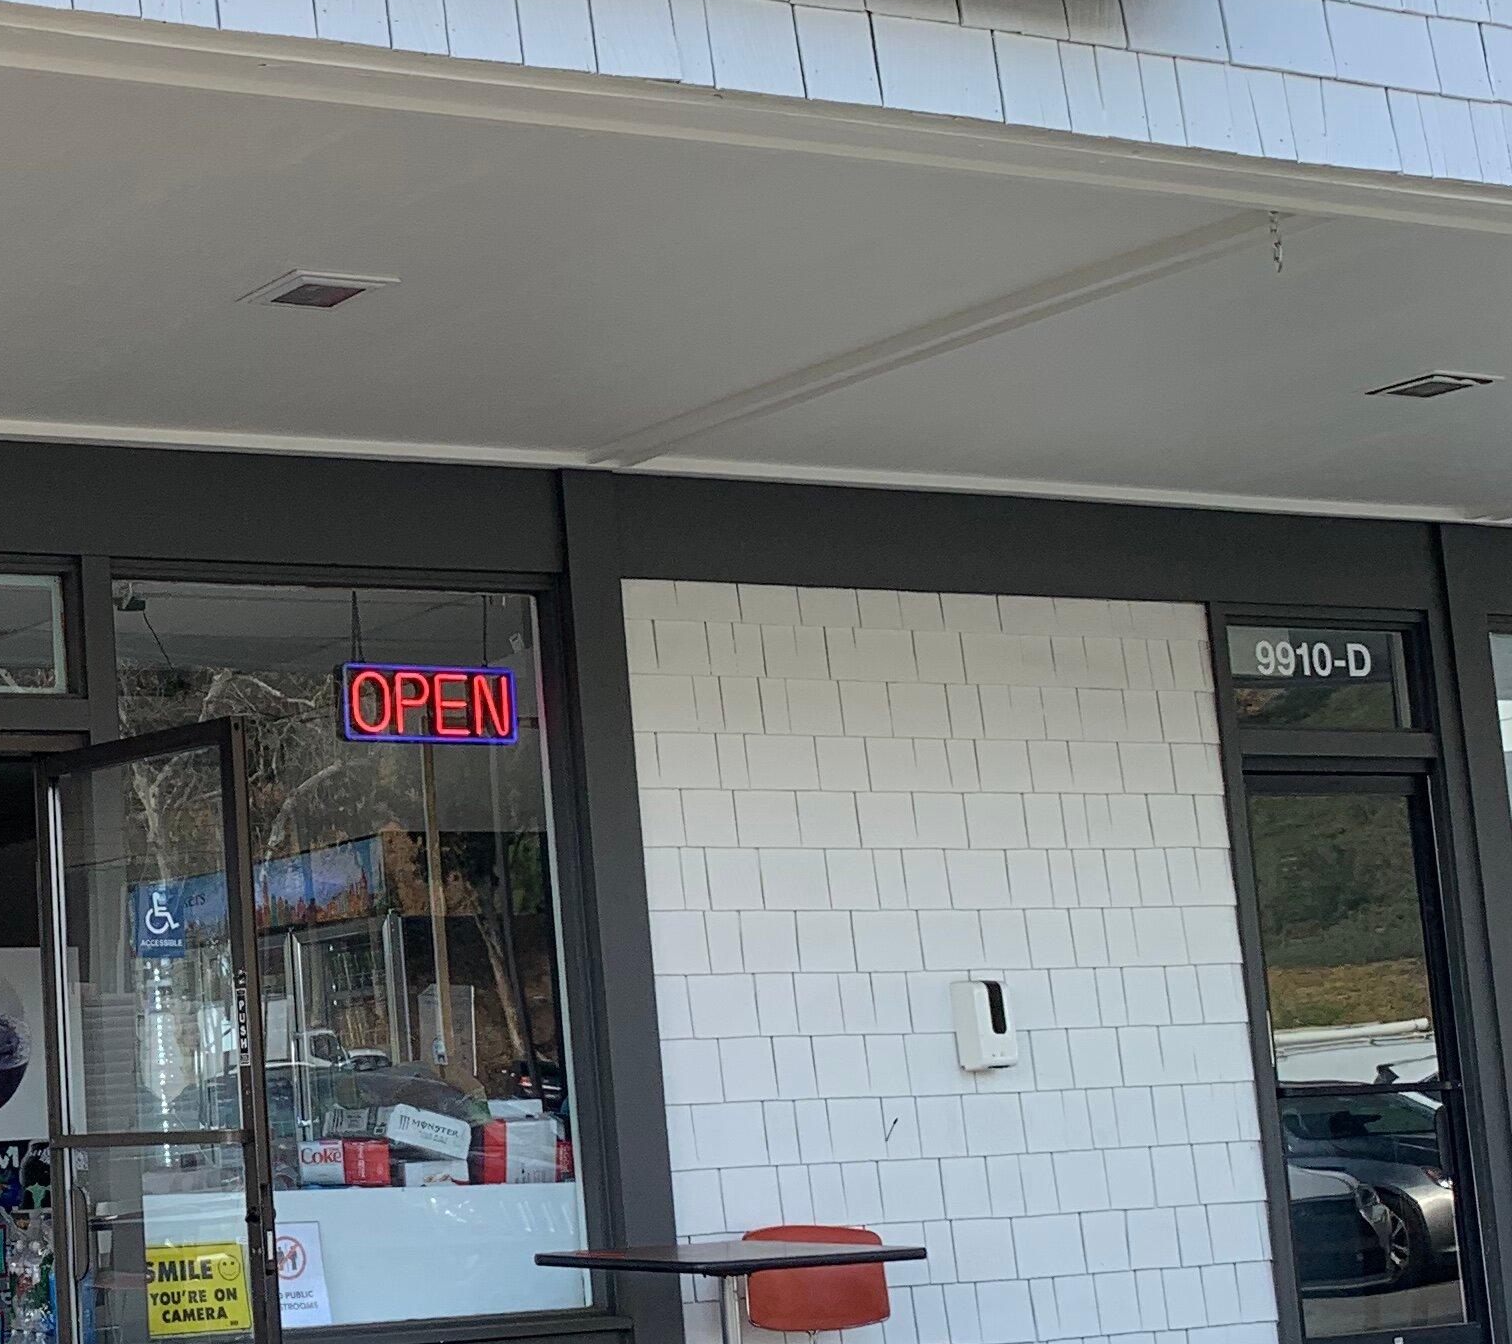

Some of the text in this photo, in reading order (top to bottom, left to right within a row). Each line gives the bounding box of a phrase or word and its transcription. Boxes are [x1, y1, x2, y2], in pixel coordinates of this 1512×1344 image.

[1255, 640, 1372, 677] 9910-D
[351, 670, 510, 737] OPEN
[140, 939, 183, 947] ACCESSIBLE
[238, 999, 248, 1049] PUSH
[411, 1118, 459, 1138] MONSTER
[300, 1146, 342, 1165] Coke
[145, 1258, 214, 1284] SMILE
[149, 1287, 238, 1306] YOU'RE ON
[285, 1290, 314, 1299] PUBLIC
[161, 1306, 229, 1324] CAMERA
